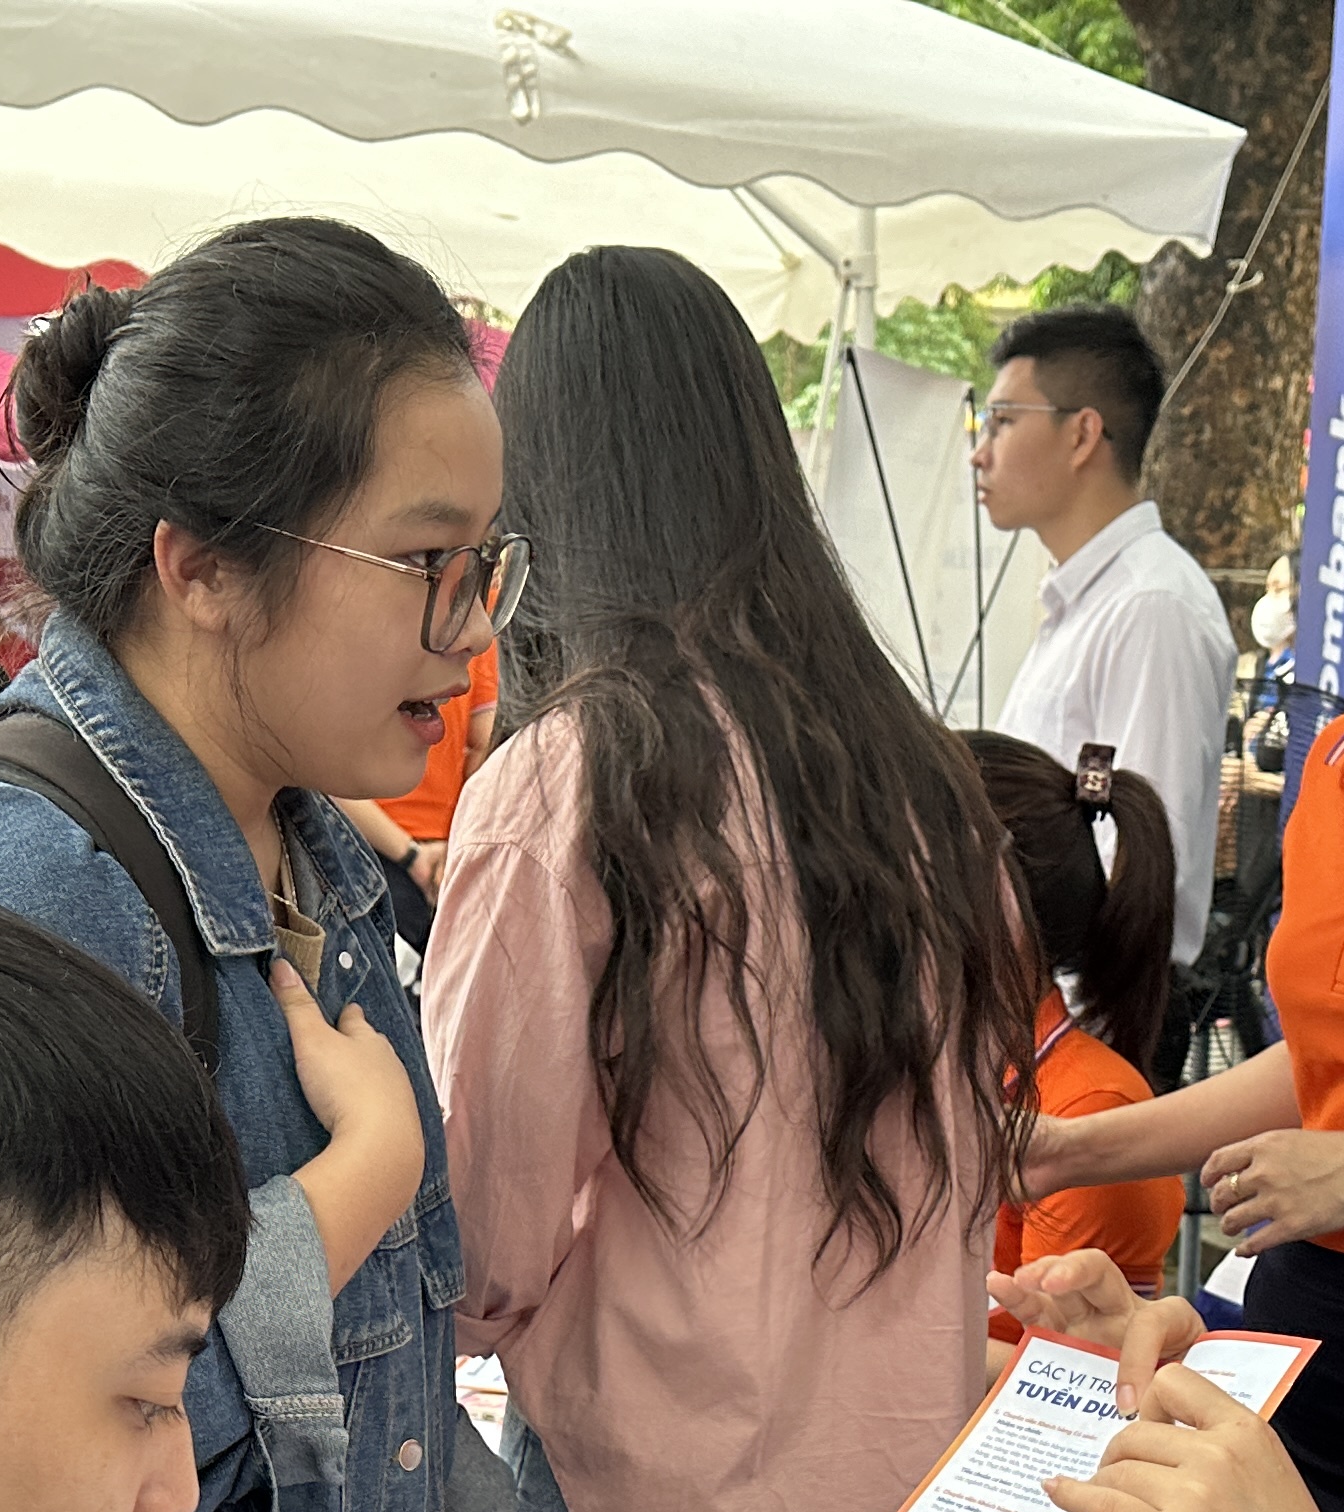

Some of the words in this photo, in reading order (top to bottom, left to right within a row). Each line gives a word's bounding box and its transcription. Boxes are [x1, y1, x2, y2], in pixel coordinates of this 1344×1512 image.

[1028, 1360, 1065, 1380] CÁC
[1069, 1370, 1086, 1388] VỊ
[1016, 1379, 1083, 1410] TUYỂN
